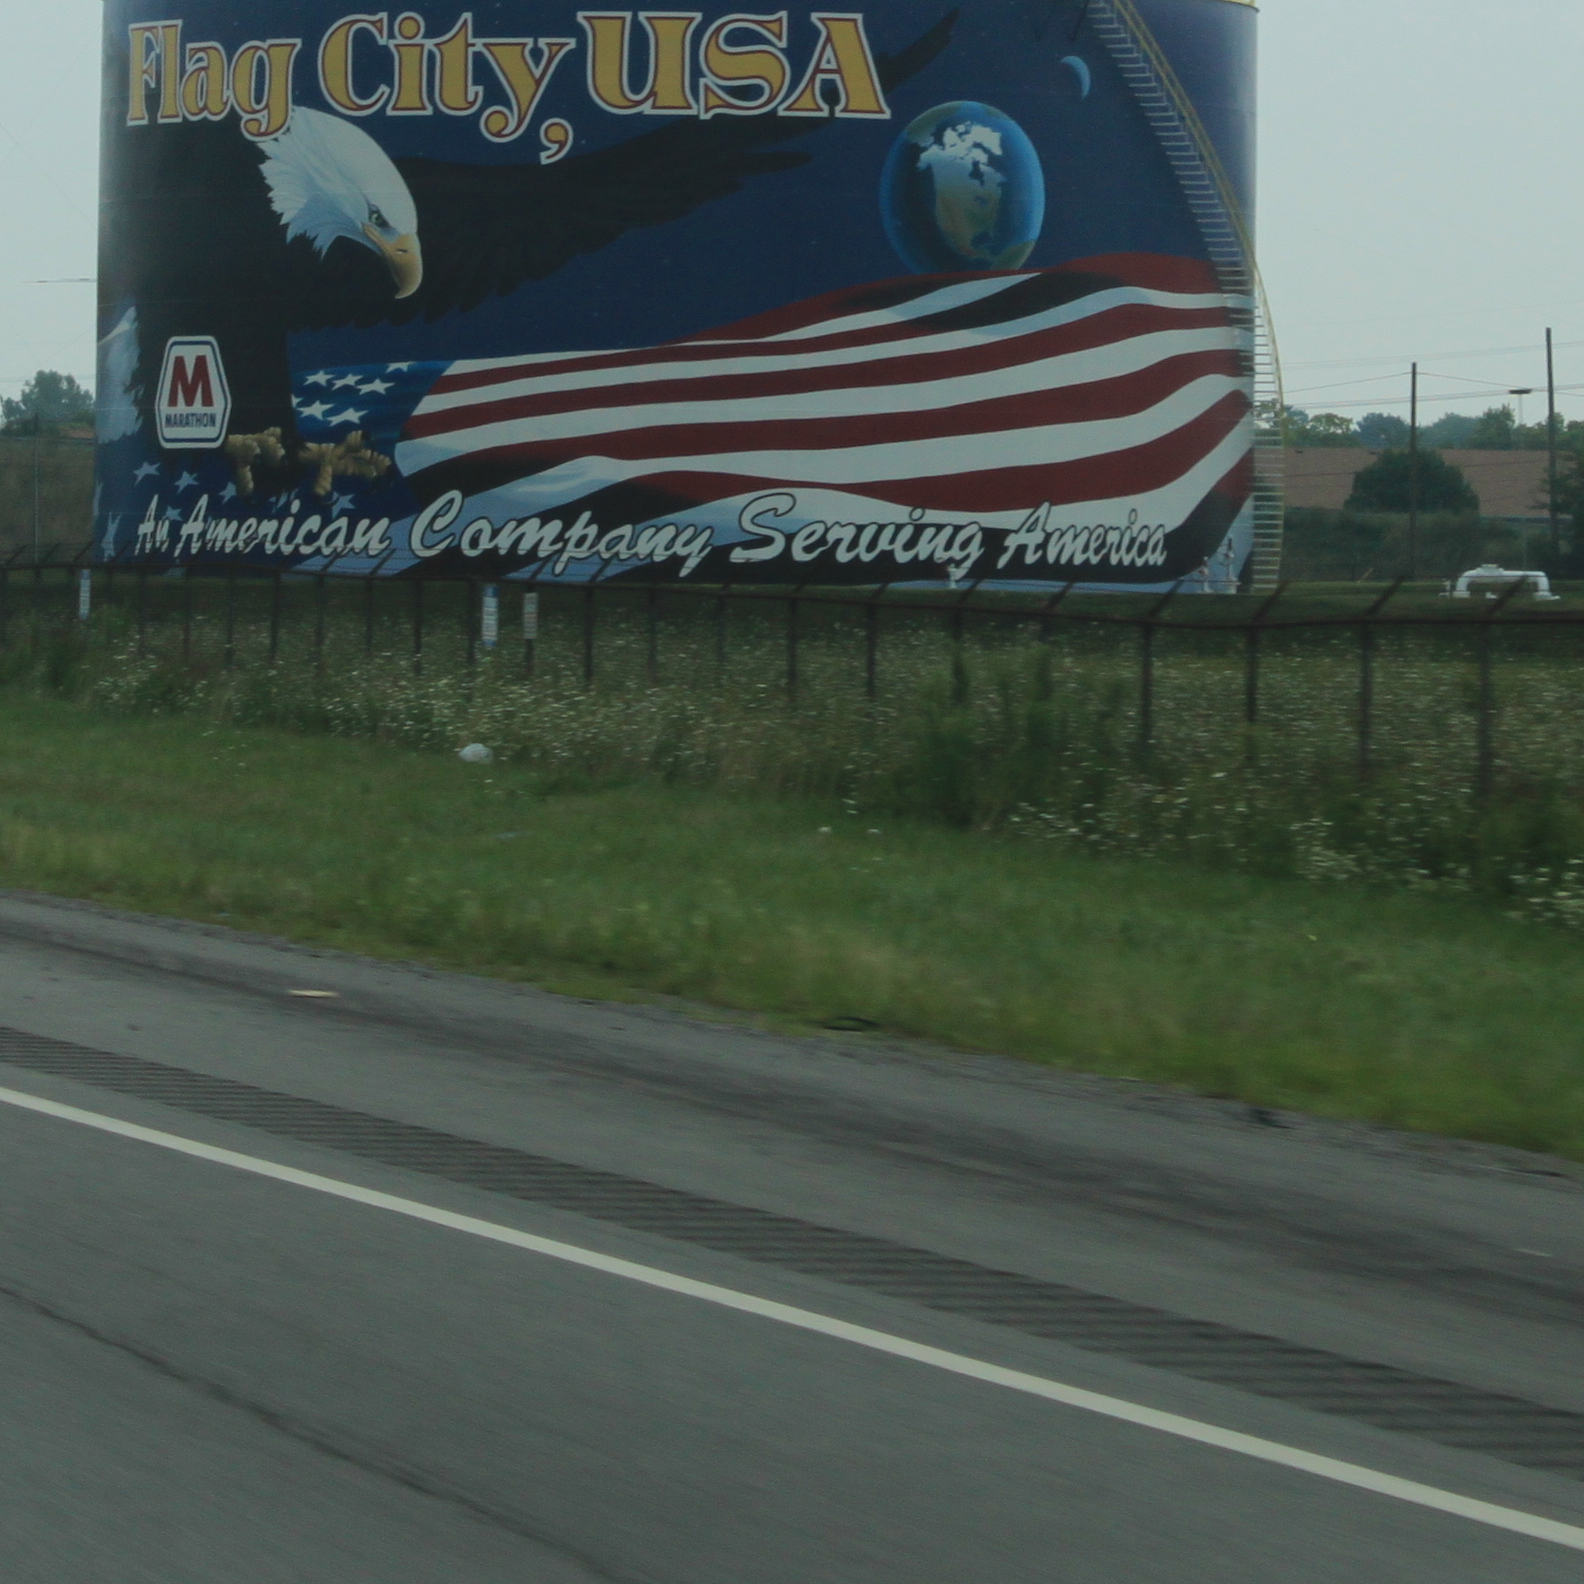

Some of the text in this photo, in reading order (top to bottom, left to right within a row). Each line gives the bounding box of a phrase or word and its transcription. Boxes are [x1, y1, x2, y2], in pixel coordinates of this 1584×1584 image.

[126, 10, 891, 166] Flag City, USA
[167, 355, 214, 407] M
[164, 412, 216, 428] MARATHON
[135, 489, 1168, 581] An American Company Serving America
